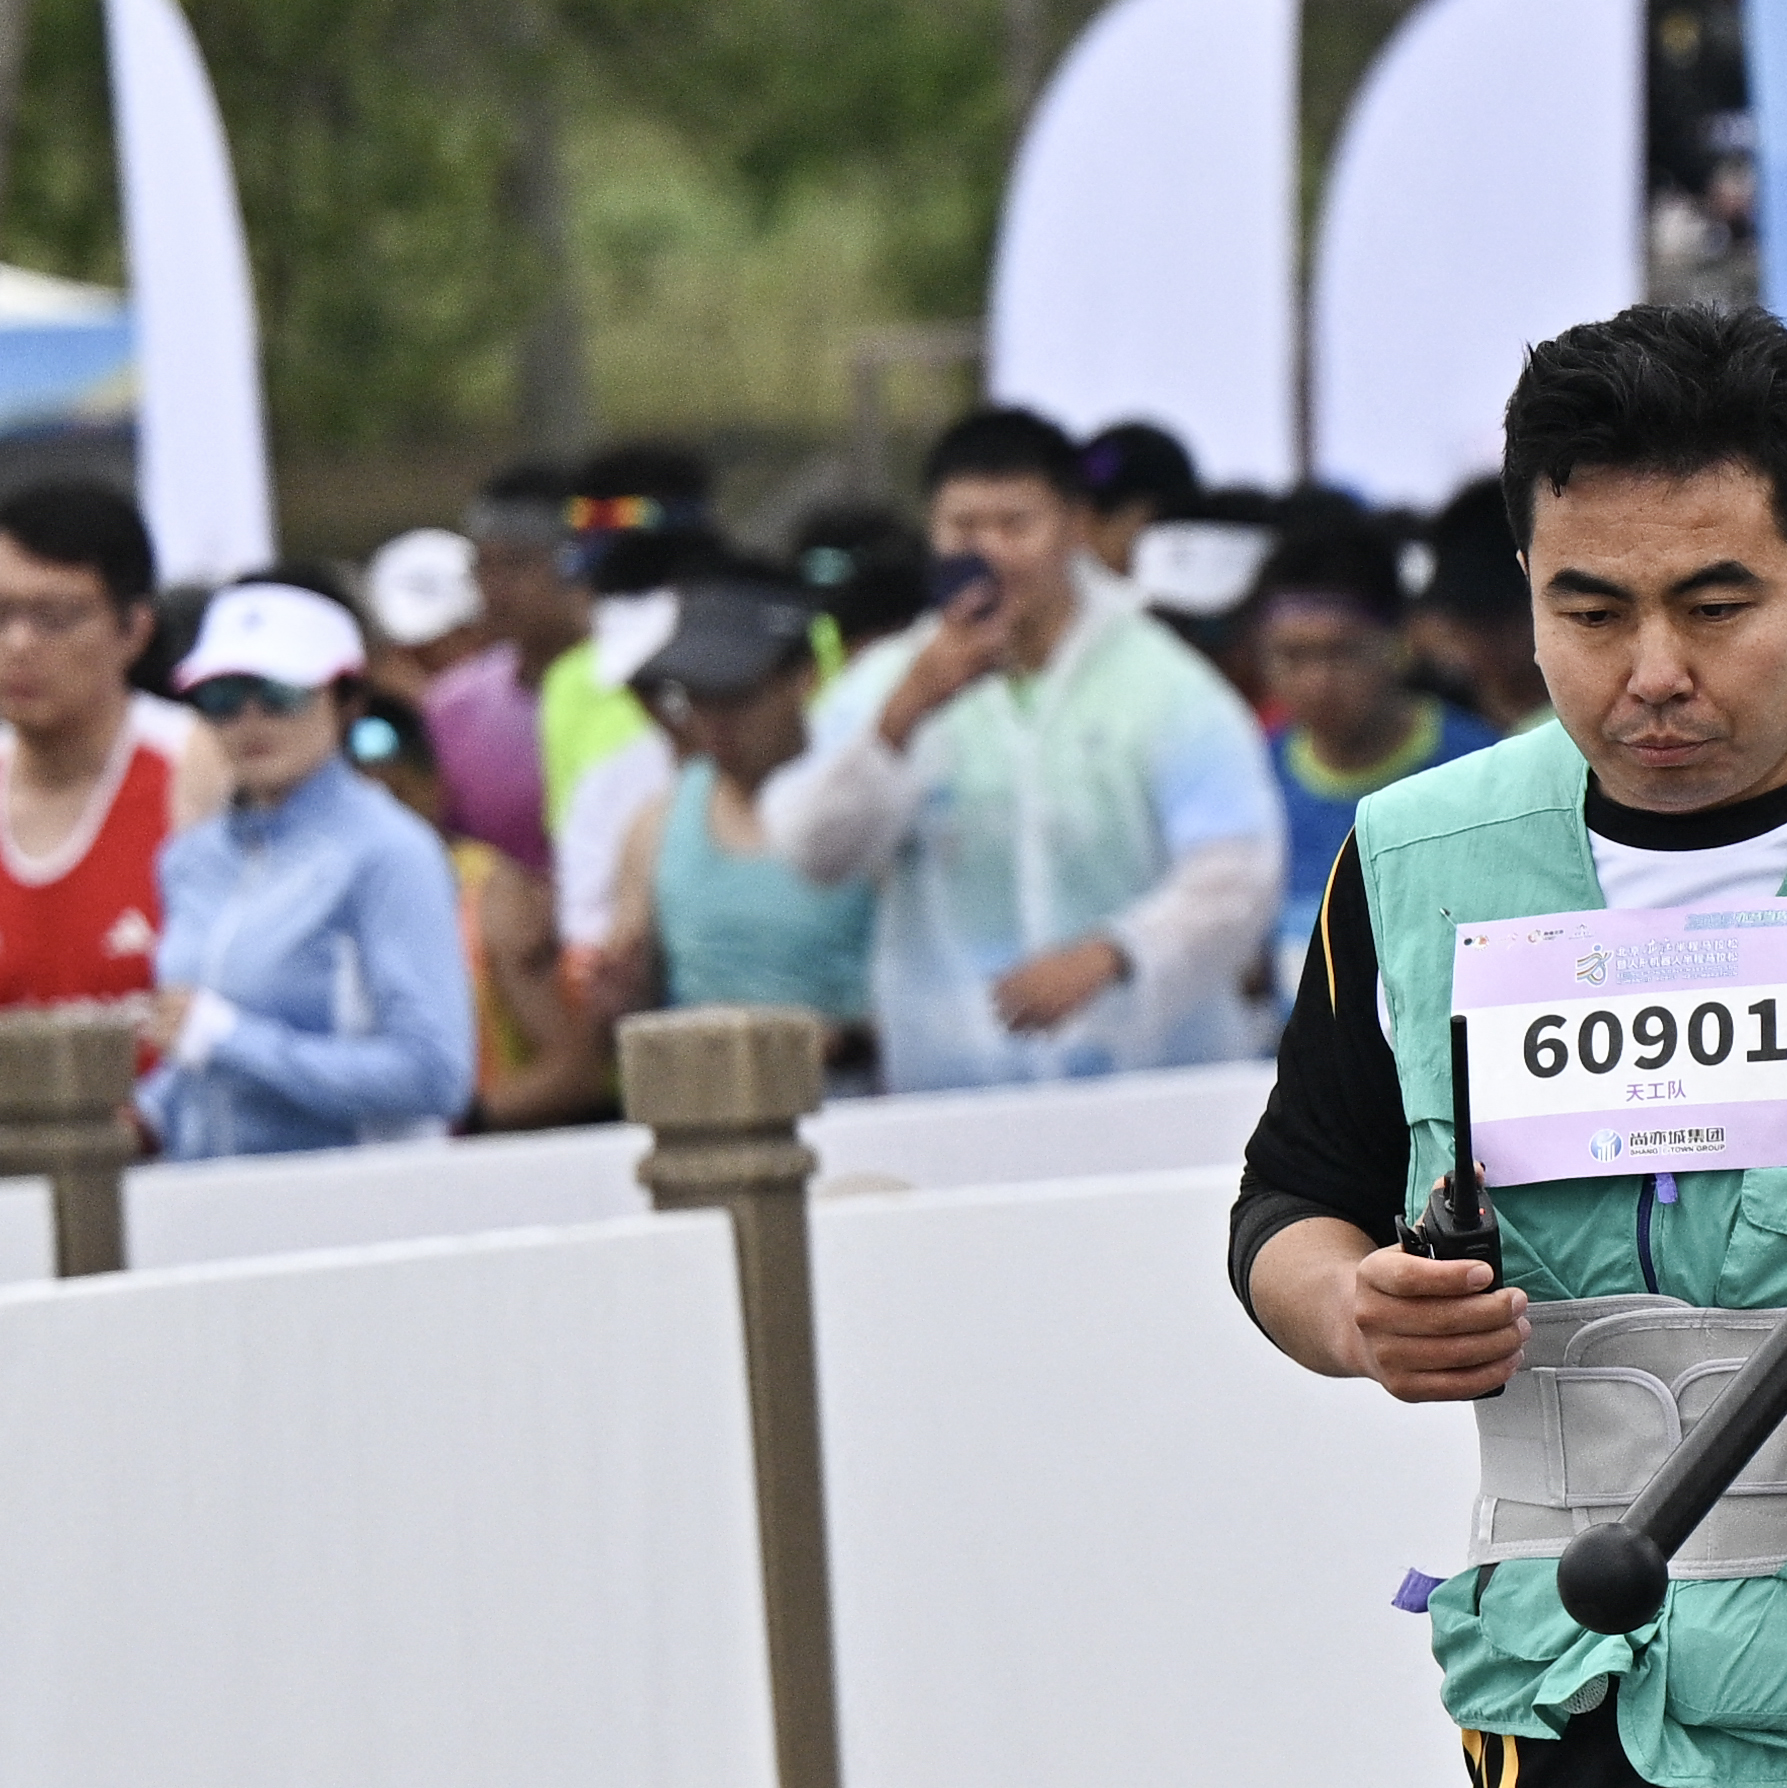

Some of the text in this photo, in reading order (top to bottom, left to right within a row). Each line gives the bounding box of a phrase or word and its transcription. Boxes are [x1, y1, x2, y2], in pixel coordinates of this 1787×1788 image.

[1524, 998, 1787, 1078] 60901
[1626, 1079, 1687, 1102] 天工队
[1629, 1127, 1725, 1146] 尚亦城集团
